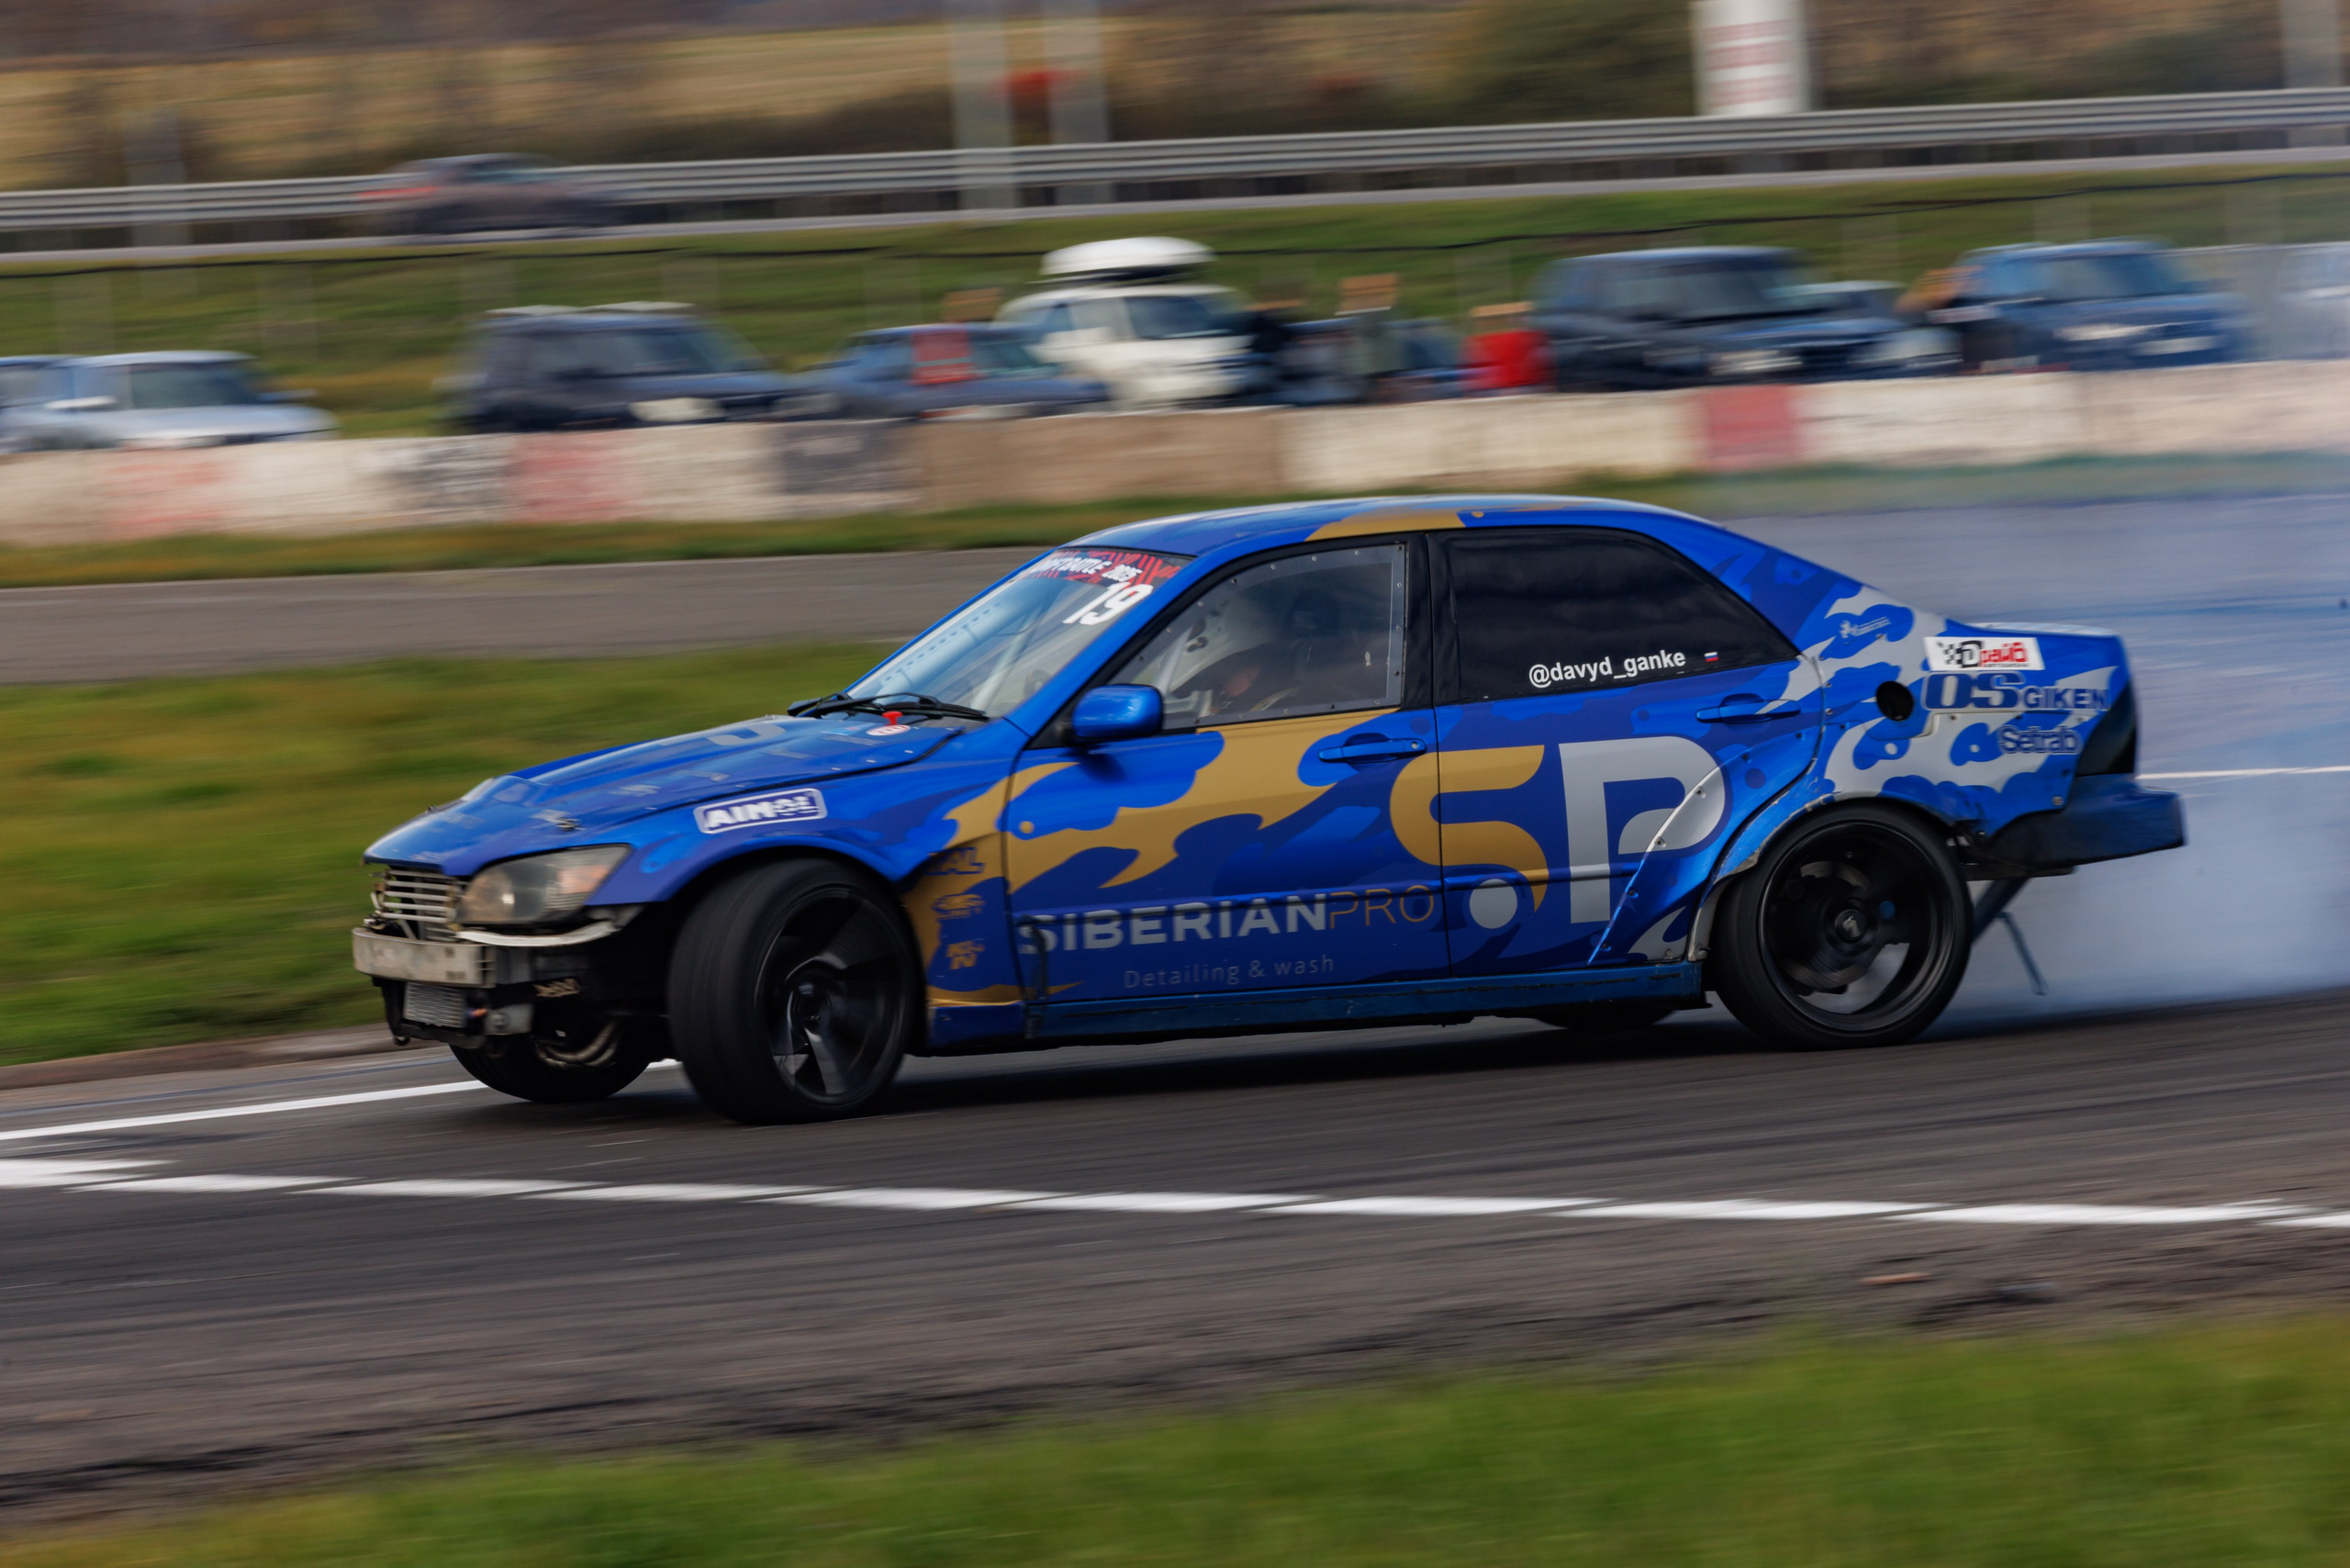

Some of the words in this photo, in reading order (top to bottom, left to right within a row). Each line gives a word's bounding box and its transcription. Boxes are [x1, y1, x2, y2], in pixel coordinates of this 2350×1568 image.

[1061, 581, 1154, 625] 19
[1528, 649, 1686, 689] @davyd_ganke
[1925, 672, 2025, 710] OS
[2023, 688, 2110, 710] GIKEN
[1998, 725, 2083, 756] Setrab
[1125, 963, 1241, 989] Detailing
[1248, 958, 1266, 979] &
[1275, 953, 1335, 977] wash
